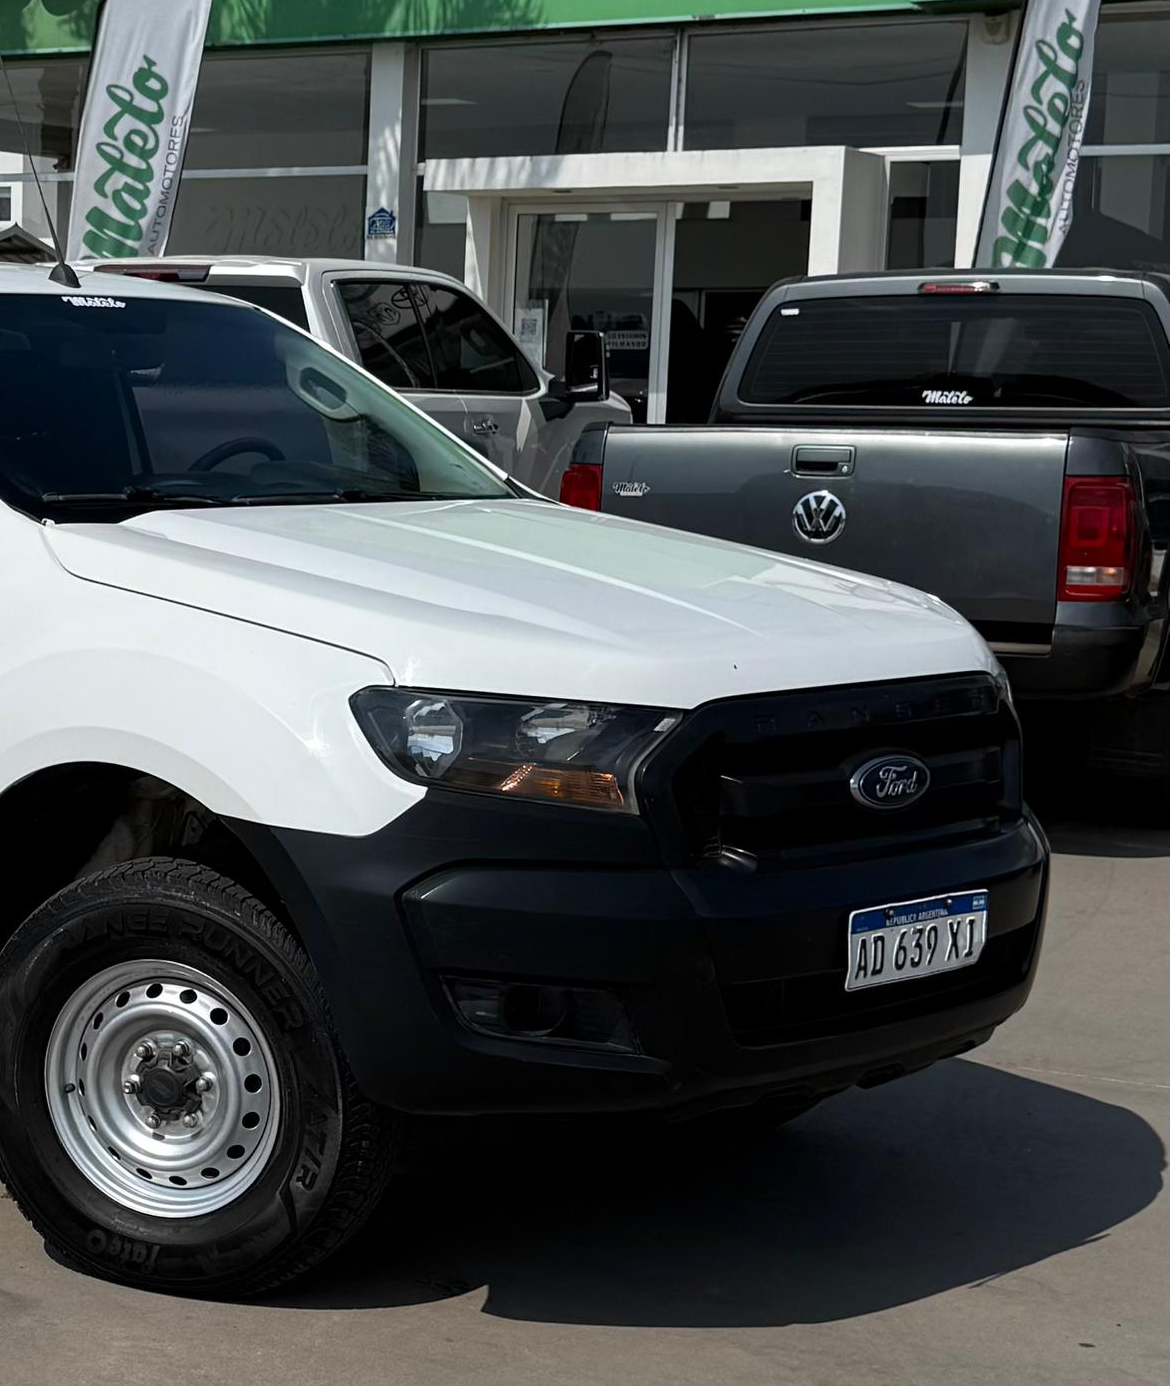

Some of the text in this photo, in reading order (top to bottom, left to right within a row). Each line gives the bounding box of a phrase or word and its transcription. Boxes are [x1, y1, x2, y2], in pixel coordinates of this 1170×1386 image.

[876, 765, 918, 798] Ford
[855, 933, 885, 980] AD
[892, 923, 939, 971] 639
